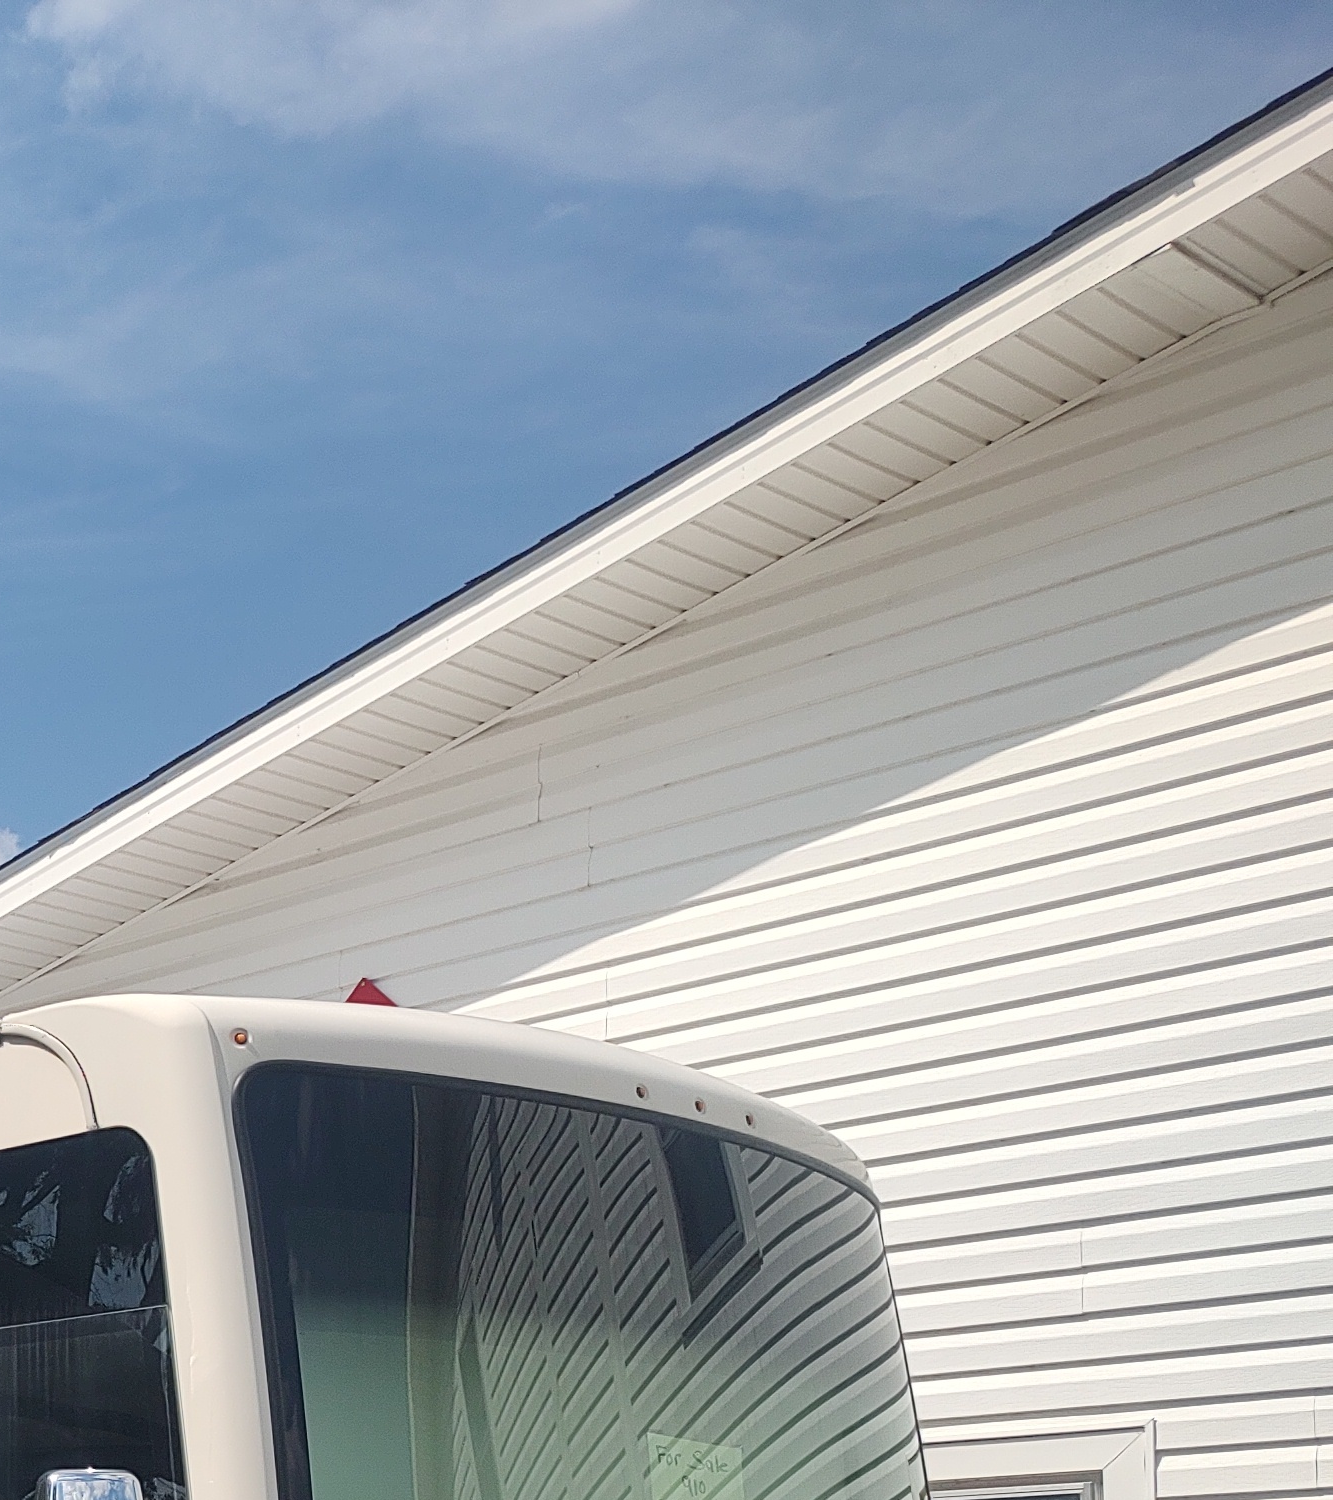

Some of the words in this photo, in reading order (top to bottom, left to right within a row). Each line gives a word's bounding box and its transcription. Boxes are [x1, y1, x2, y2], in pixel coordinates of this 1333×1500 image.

[655, 1444, 682, 1466] For
[687, 1450, 728, 1473] Sale
[682, 1475, 706, 1497] 910
